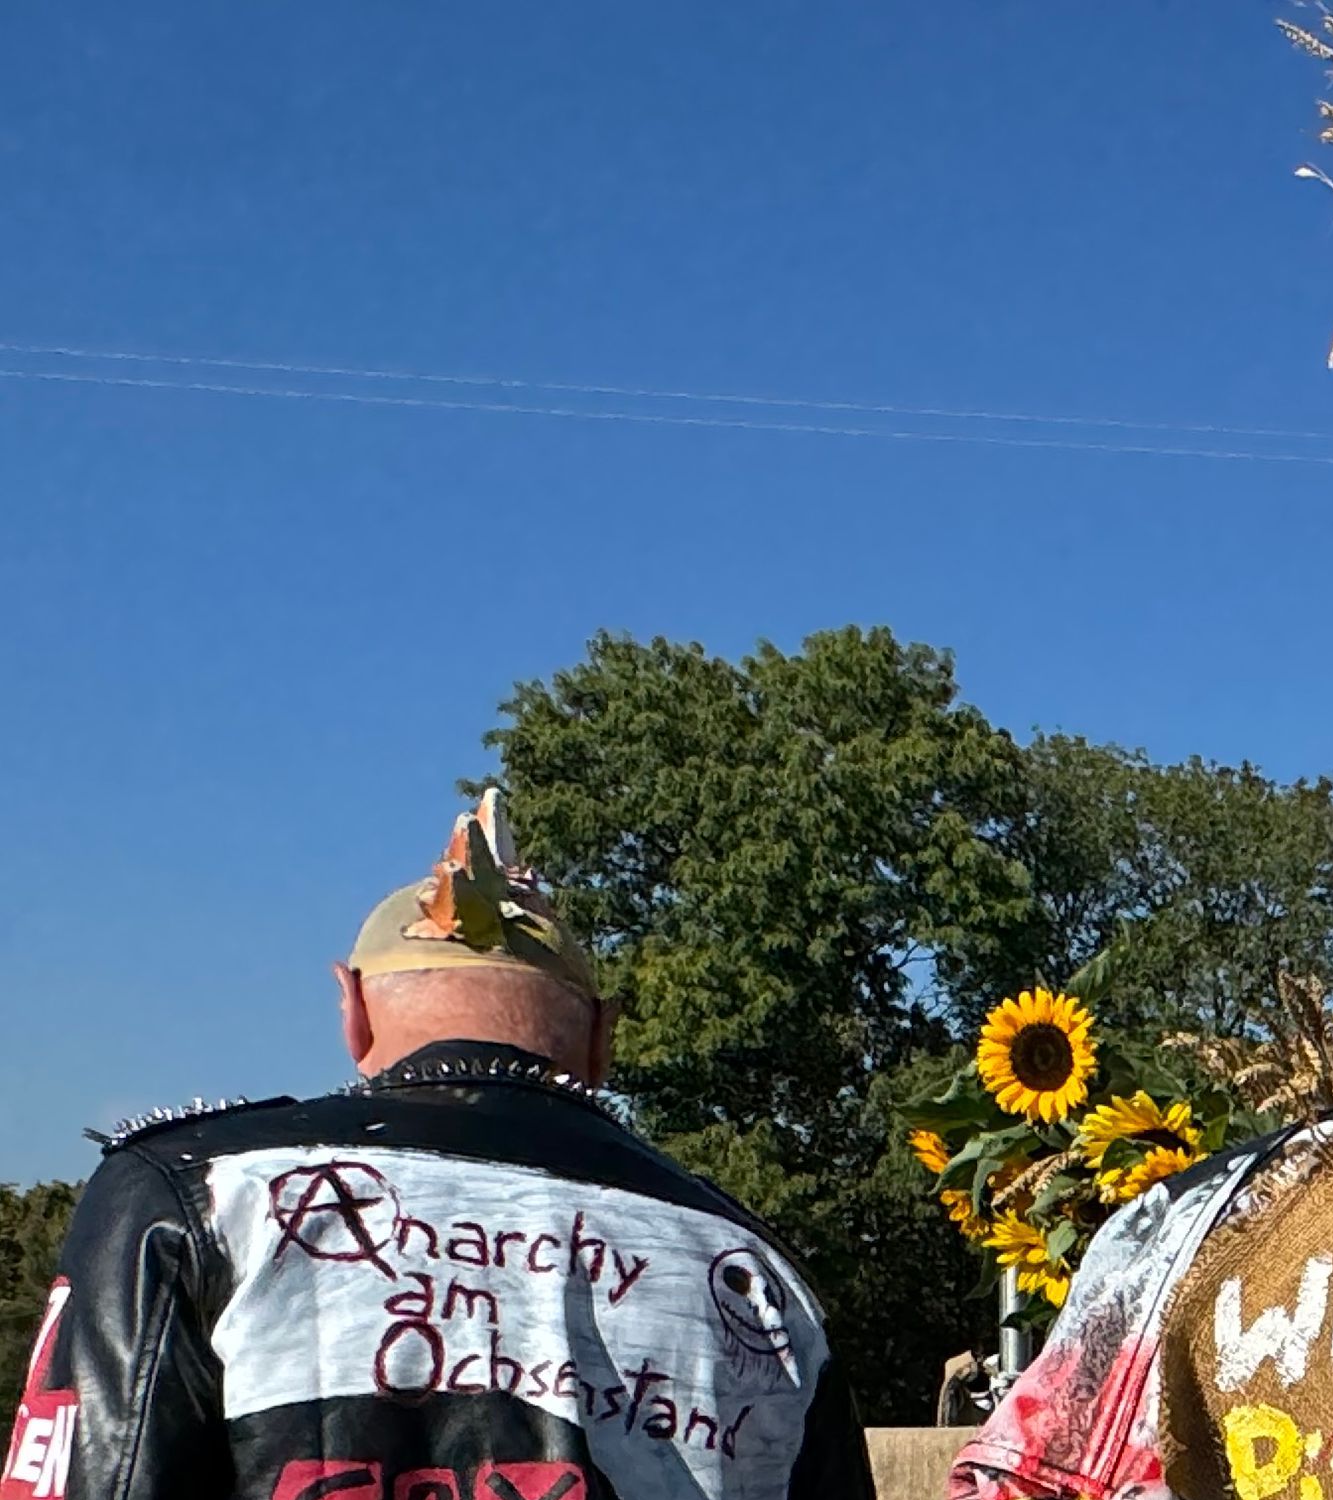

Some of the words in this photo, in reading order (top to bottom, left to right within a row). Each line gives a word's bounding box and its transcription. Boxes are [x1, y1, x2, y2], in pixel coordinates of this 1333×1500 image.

[269, 1159, 648, 1305] Anarchy
[384, 1270, 500, 1327] am
[0, 1403, 78, 1498] EN
